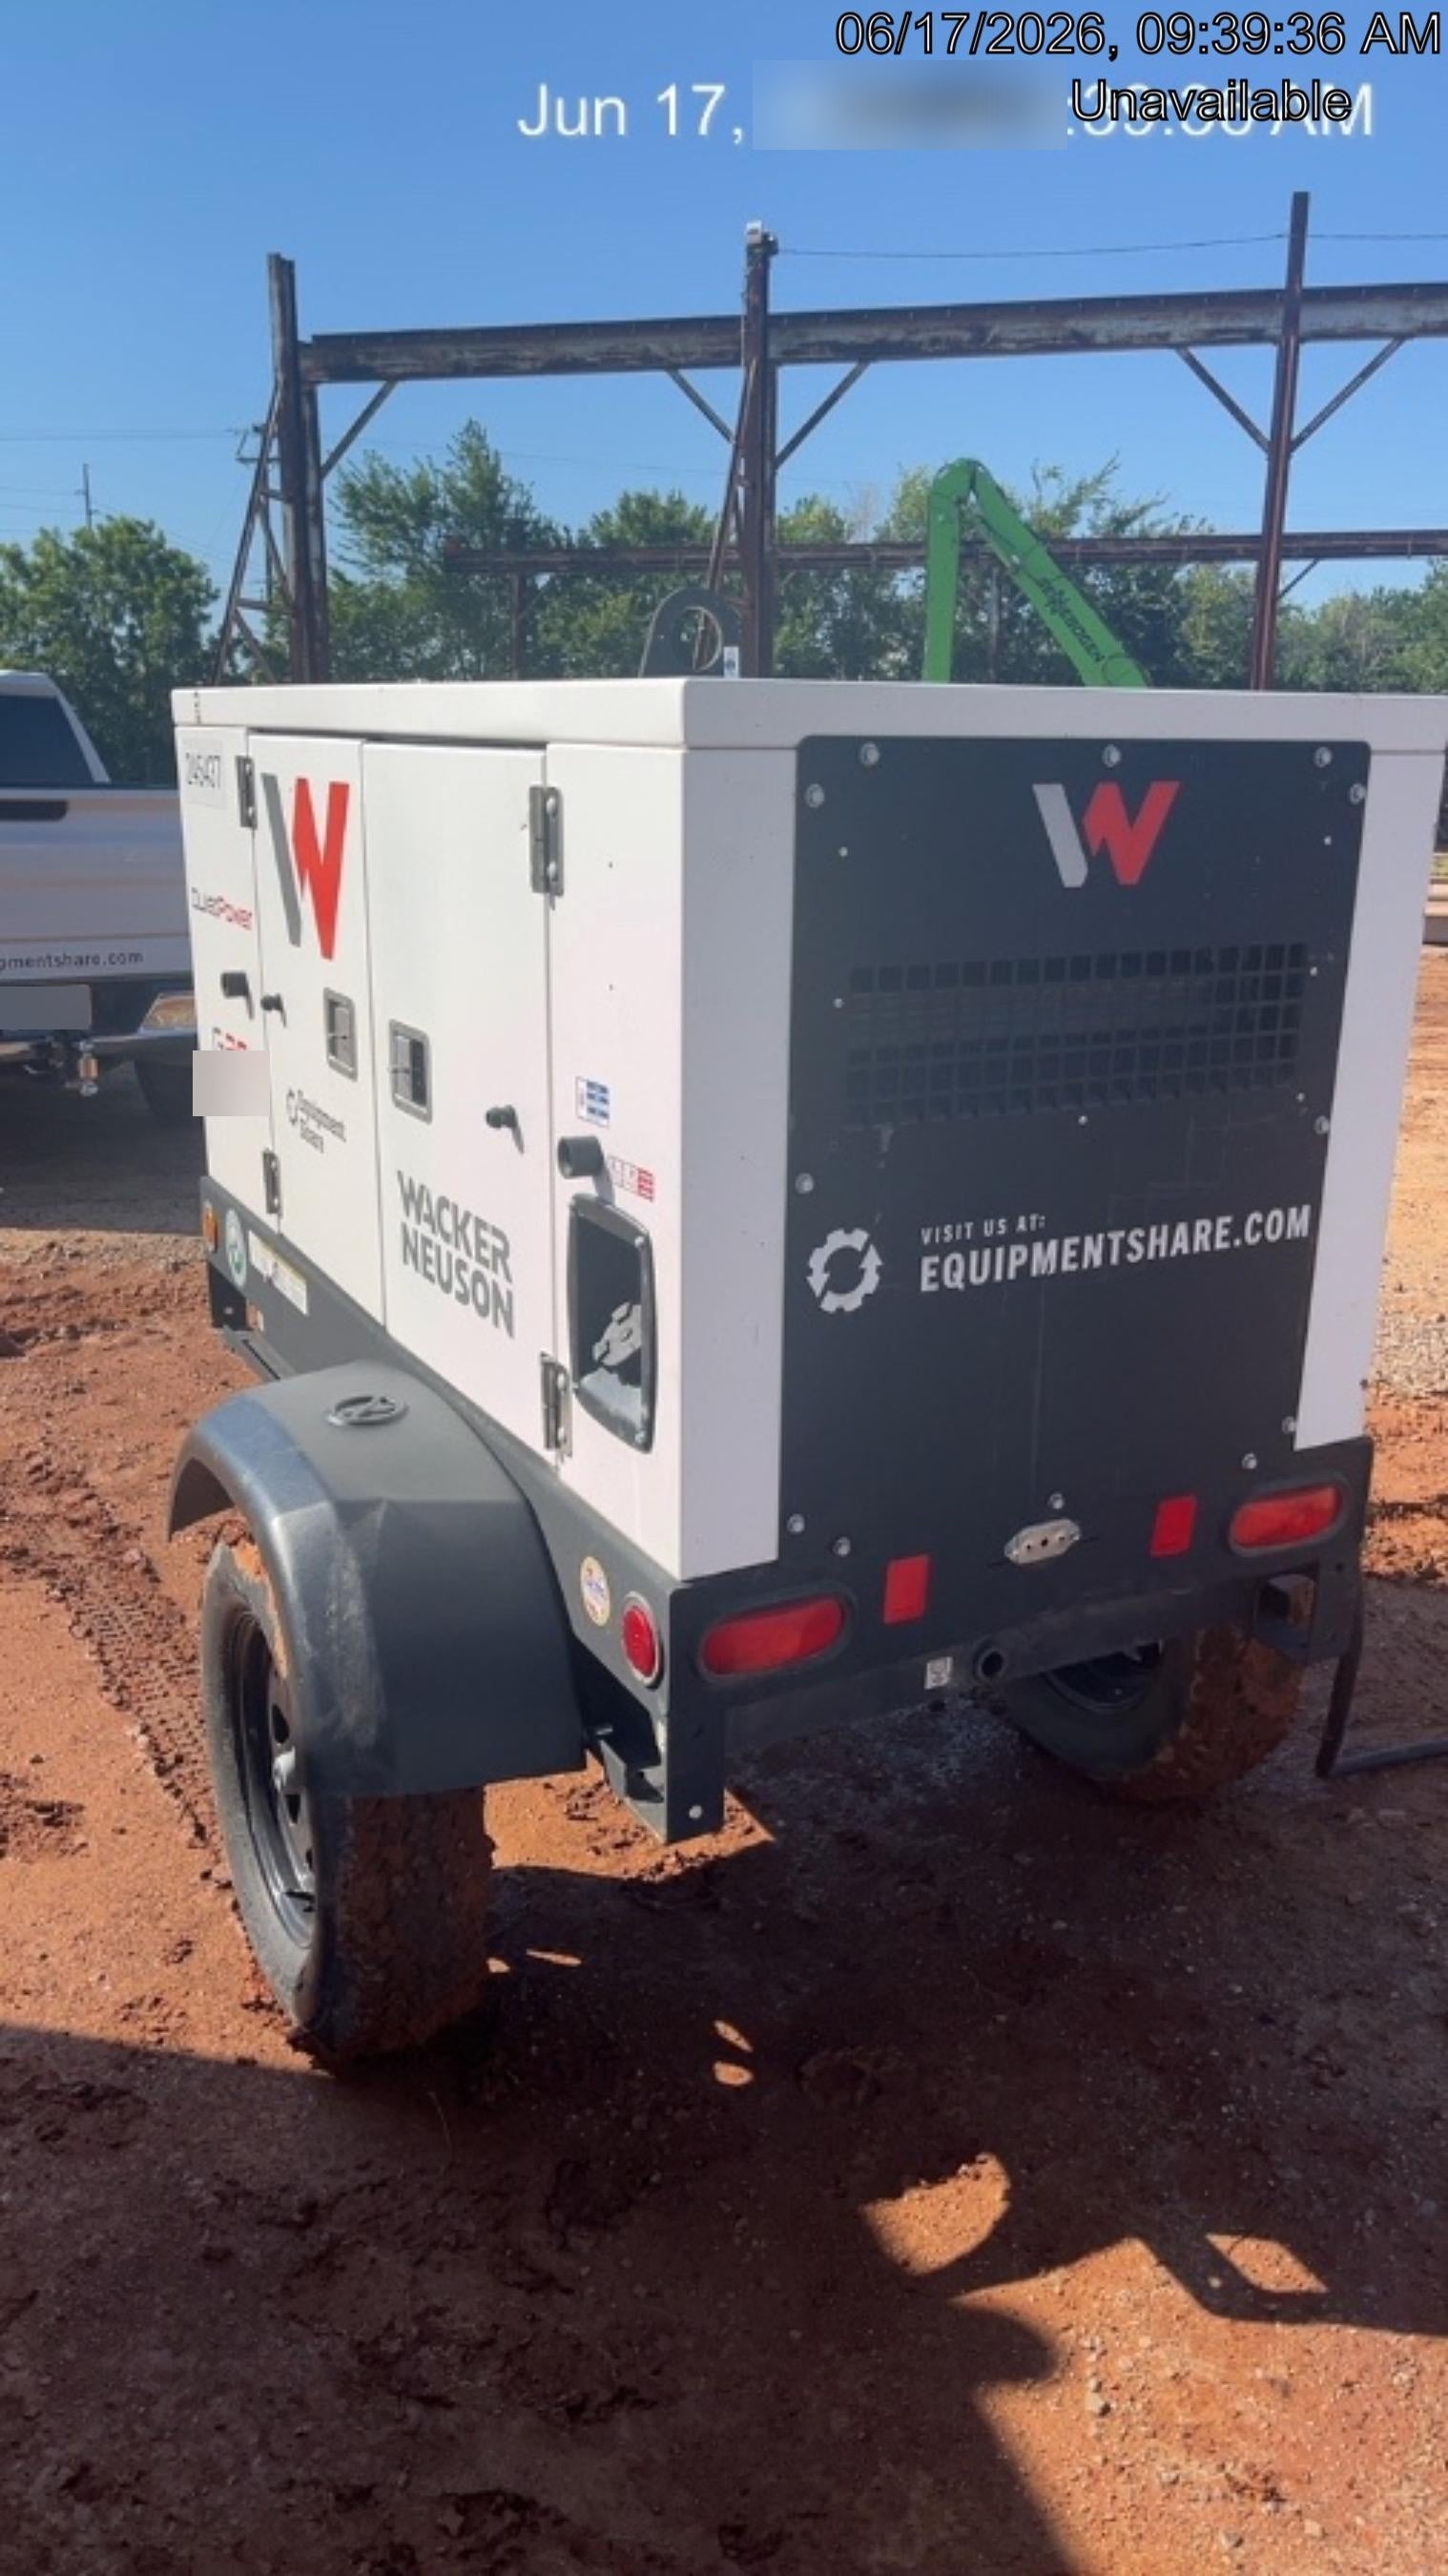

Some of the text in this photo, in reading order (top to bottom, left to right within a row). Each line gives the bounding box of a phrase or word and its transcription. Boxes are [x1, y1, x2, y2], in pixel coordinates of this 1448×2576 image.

[397, 1169, 512, 1284] WACKER
[921, 1213, 1045, 1246] VISIT US AT:
[921, 1204, 1312, 1293] EQUIPMENTSHARE.COM
[401, 1220, 515, 1340] NEUSON
